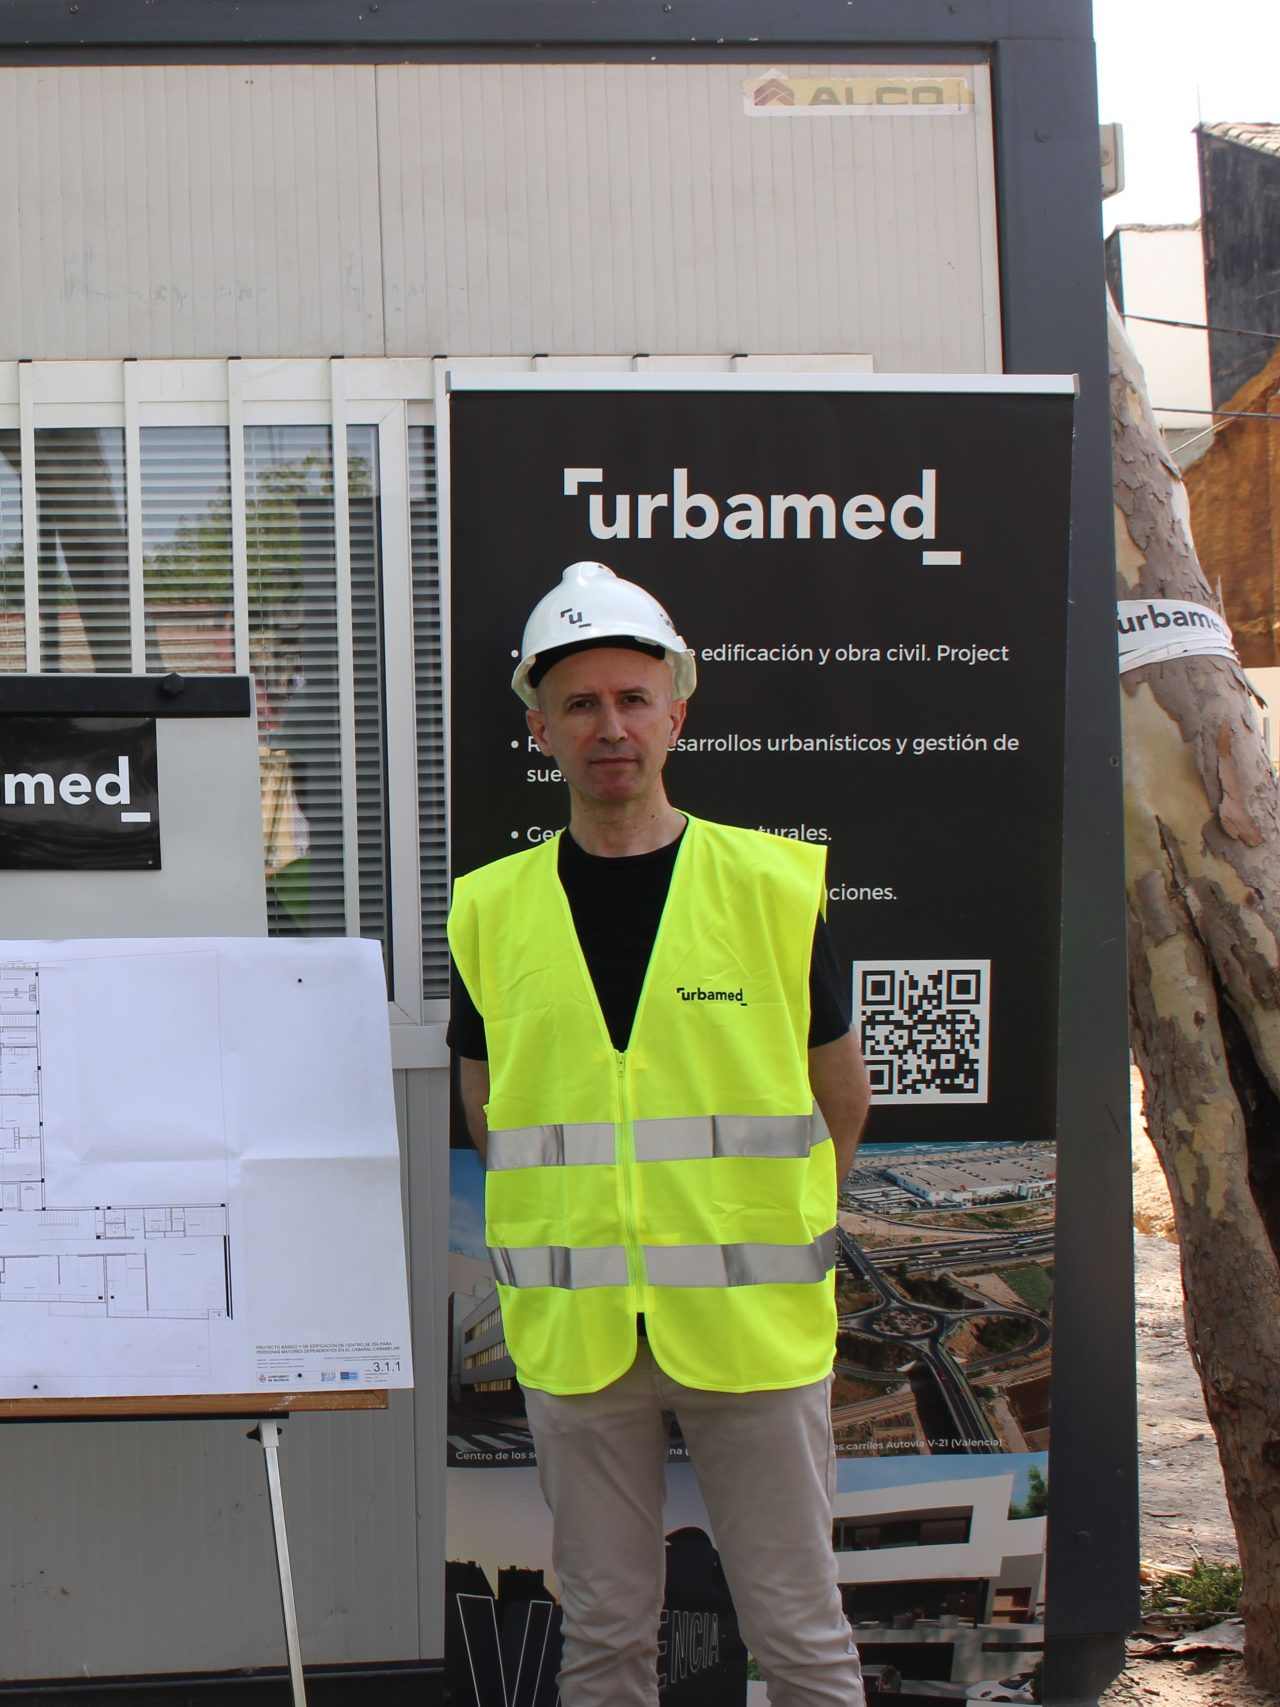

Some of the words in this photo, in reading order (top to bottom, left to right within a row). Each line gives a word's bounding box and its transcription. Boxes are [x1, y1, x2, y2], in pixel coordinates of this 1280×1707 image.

[807, 86, 945, 106] ALCO
[588, 467, 937, 541] urbamed
[701, 643, 813, 662] edificación
[818, 648, 831, 666] y
[835, 643, 881, 662] obra
[886, 643, 931, 662] civil.
[937, 643, 1010, 666] Project
[667, 733, 762, 752] sarrollos
[767, 733, 892, 752] urbanísticos
[895, 737, 908, 756] y
[912, 733, 988, 756] gestión
[993, 733, 1020, 751] de
[826, 882, 898, 901] ciones.
[681, 986, 744, 1002] urbamed
[373, 1361, 401, 1373] 3.1.1
[927, 1438, 949, 1447] V-21
[951, 1437, 1003, 1448] (Valencia)
[456, 1451, 493, 1460] Centro
[495, 1451, 509, 1460] de
[511, 1450, 526, 1459] los
